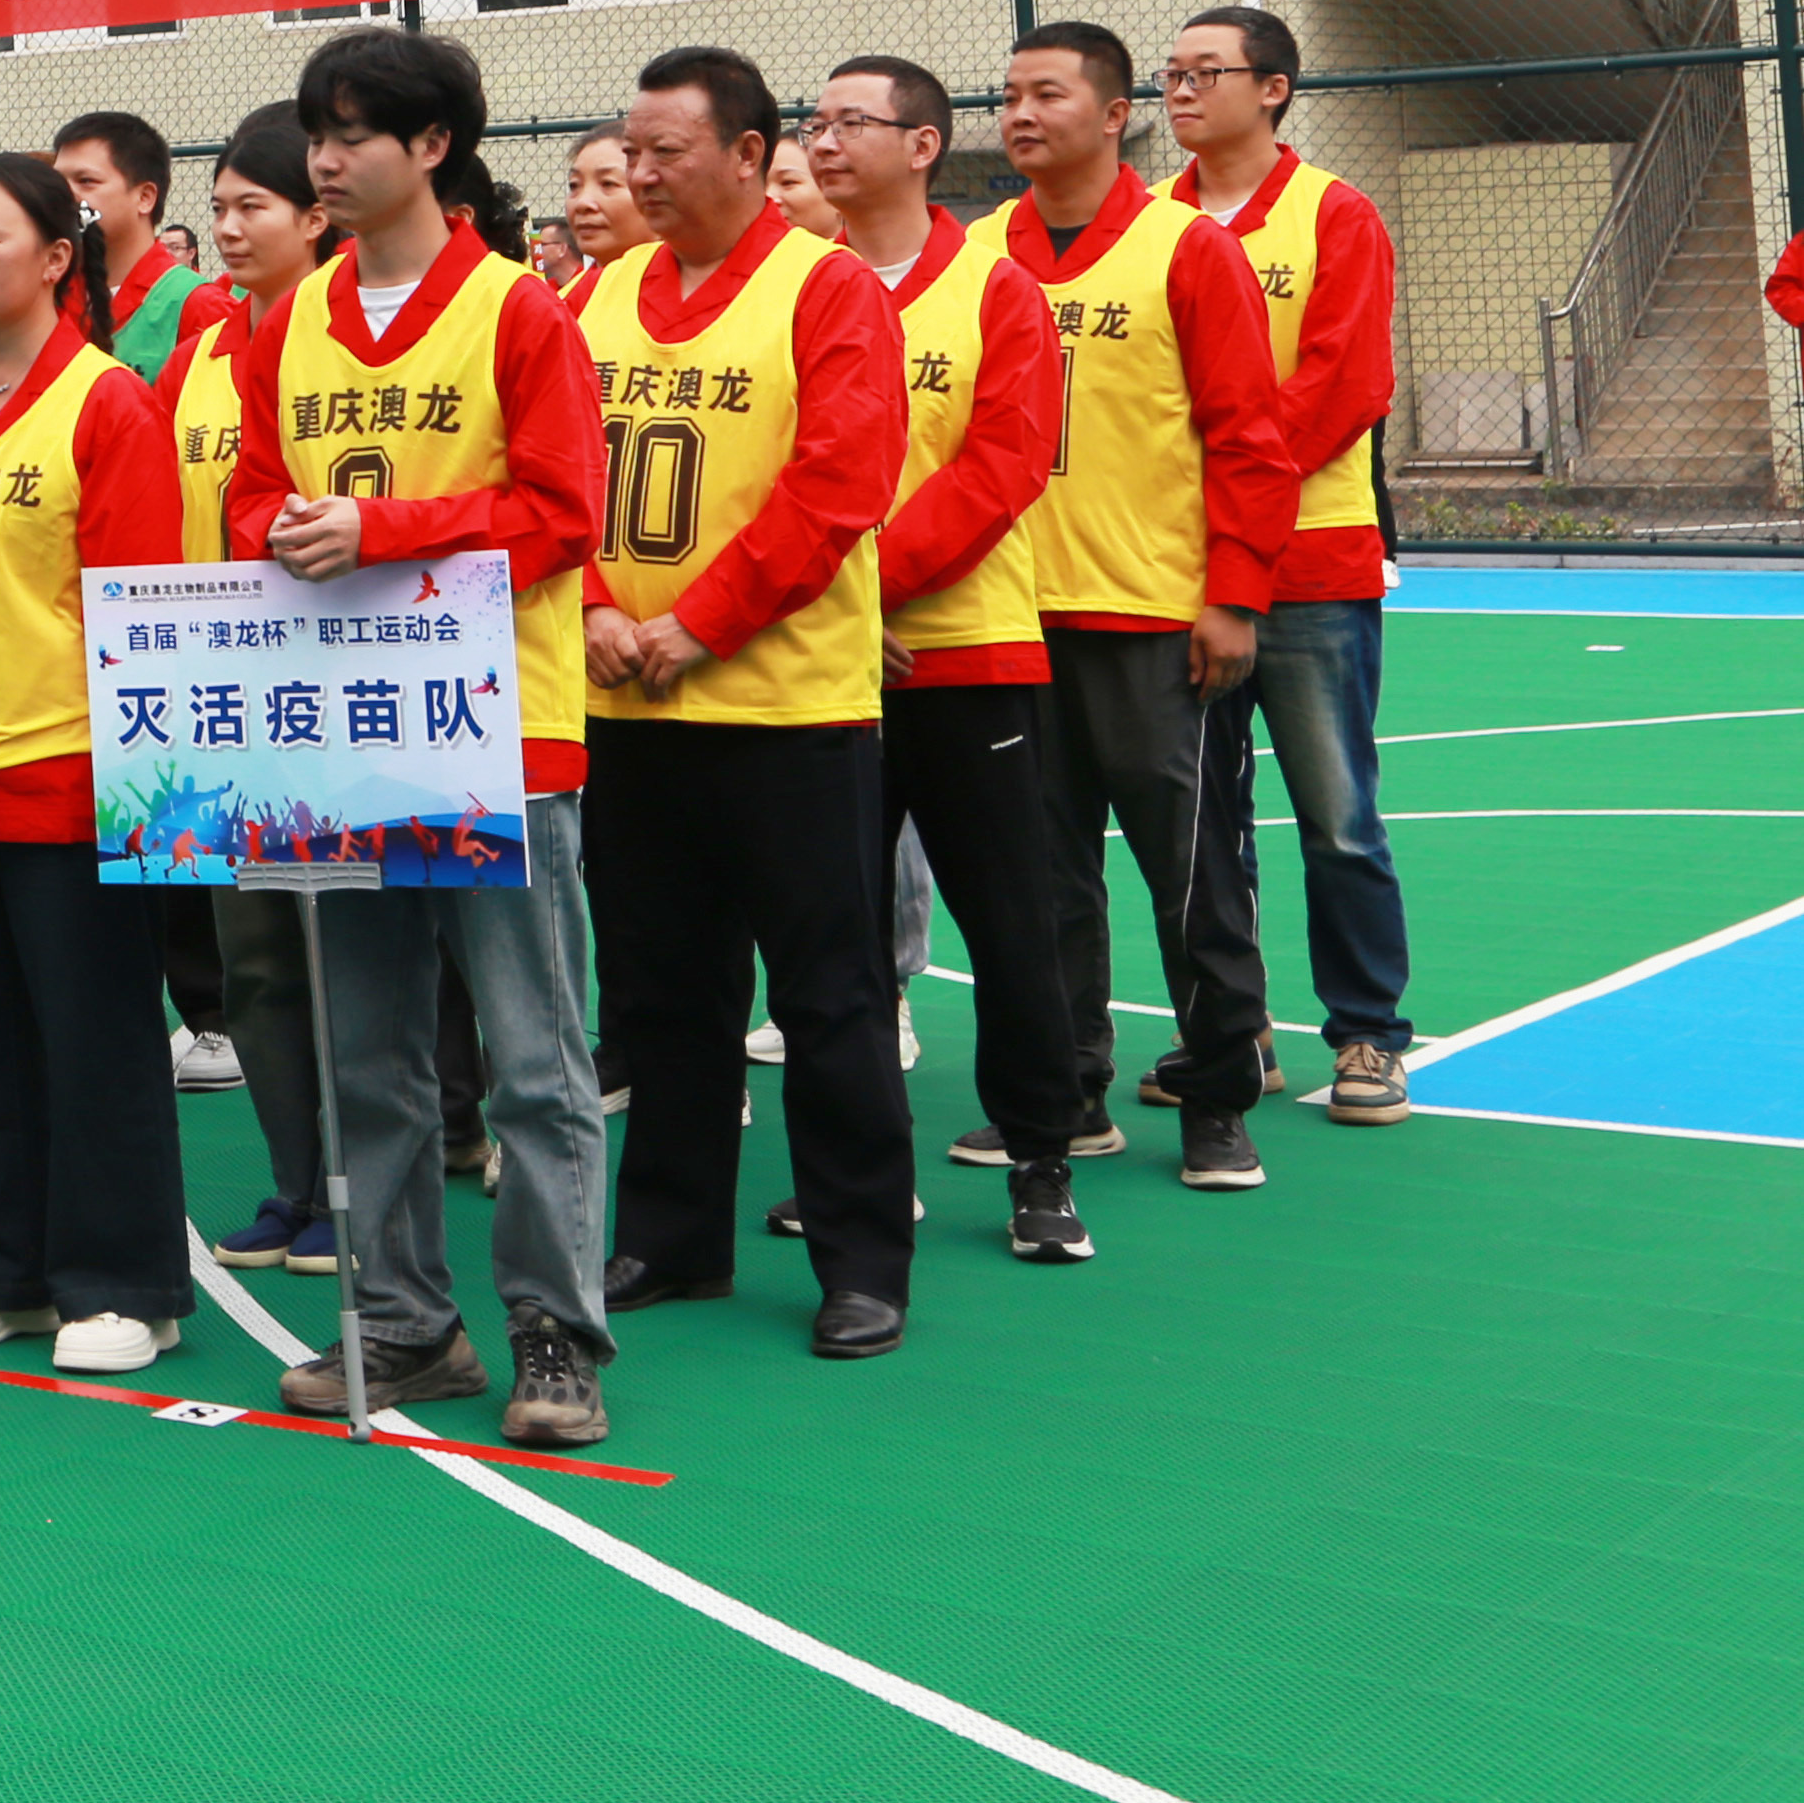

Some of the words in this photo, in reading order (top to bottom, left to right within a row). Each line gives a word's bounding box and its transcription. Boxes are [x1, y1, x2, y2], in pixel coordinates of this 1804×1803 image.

[292, 383, 463, 441] 重庆澳龙
[599, 413, 706, 566] 10
[126, 613, 461, 651] 首届“澳龙杯”职工运动会
[116, 677, 485, 746] 灭活疫苗队
